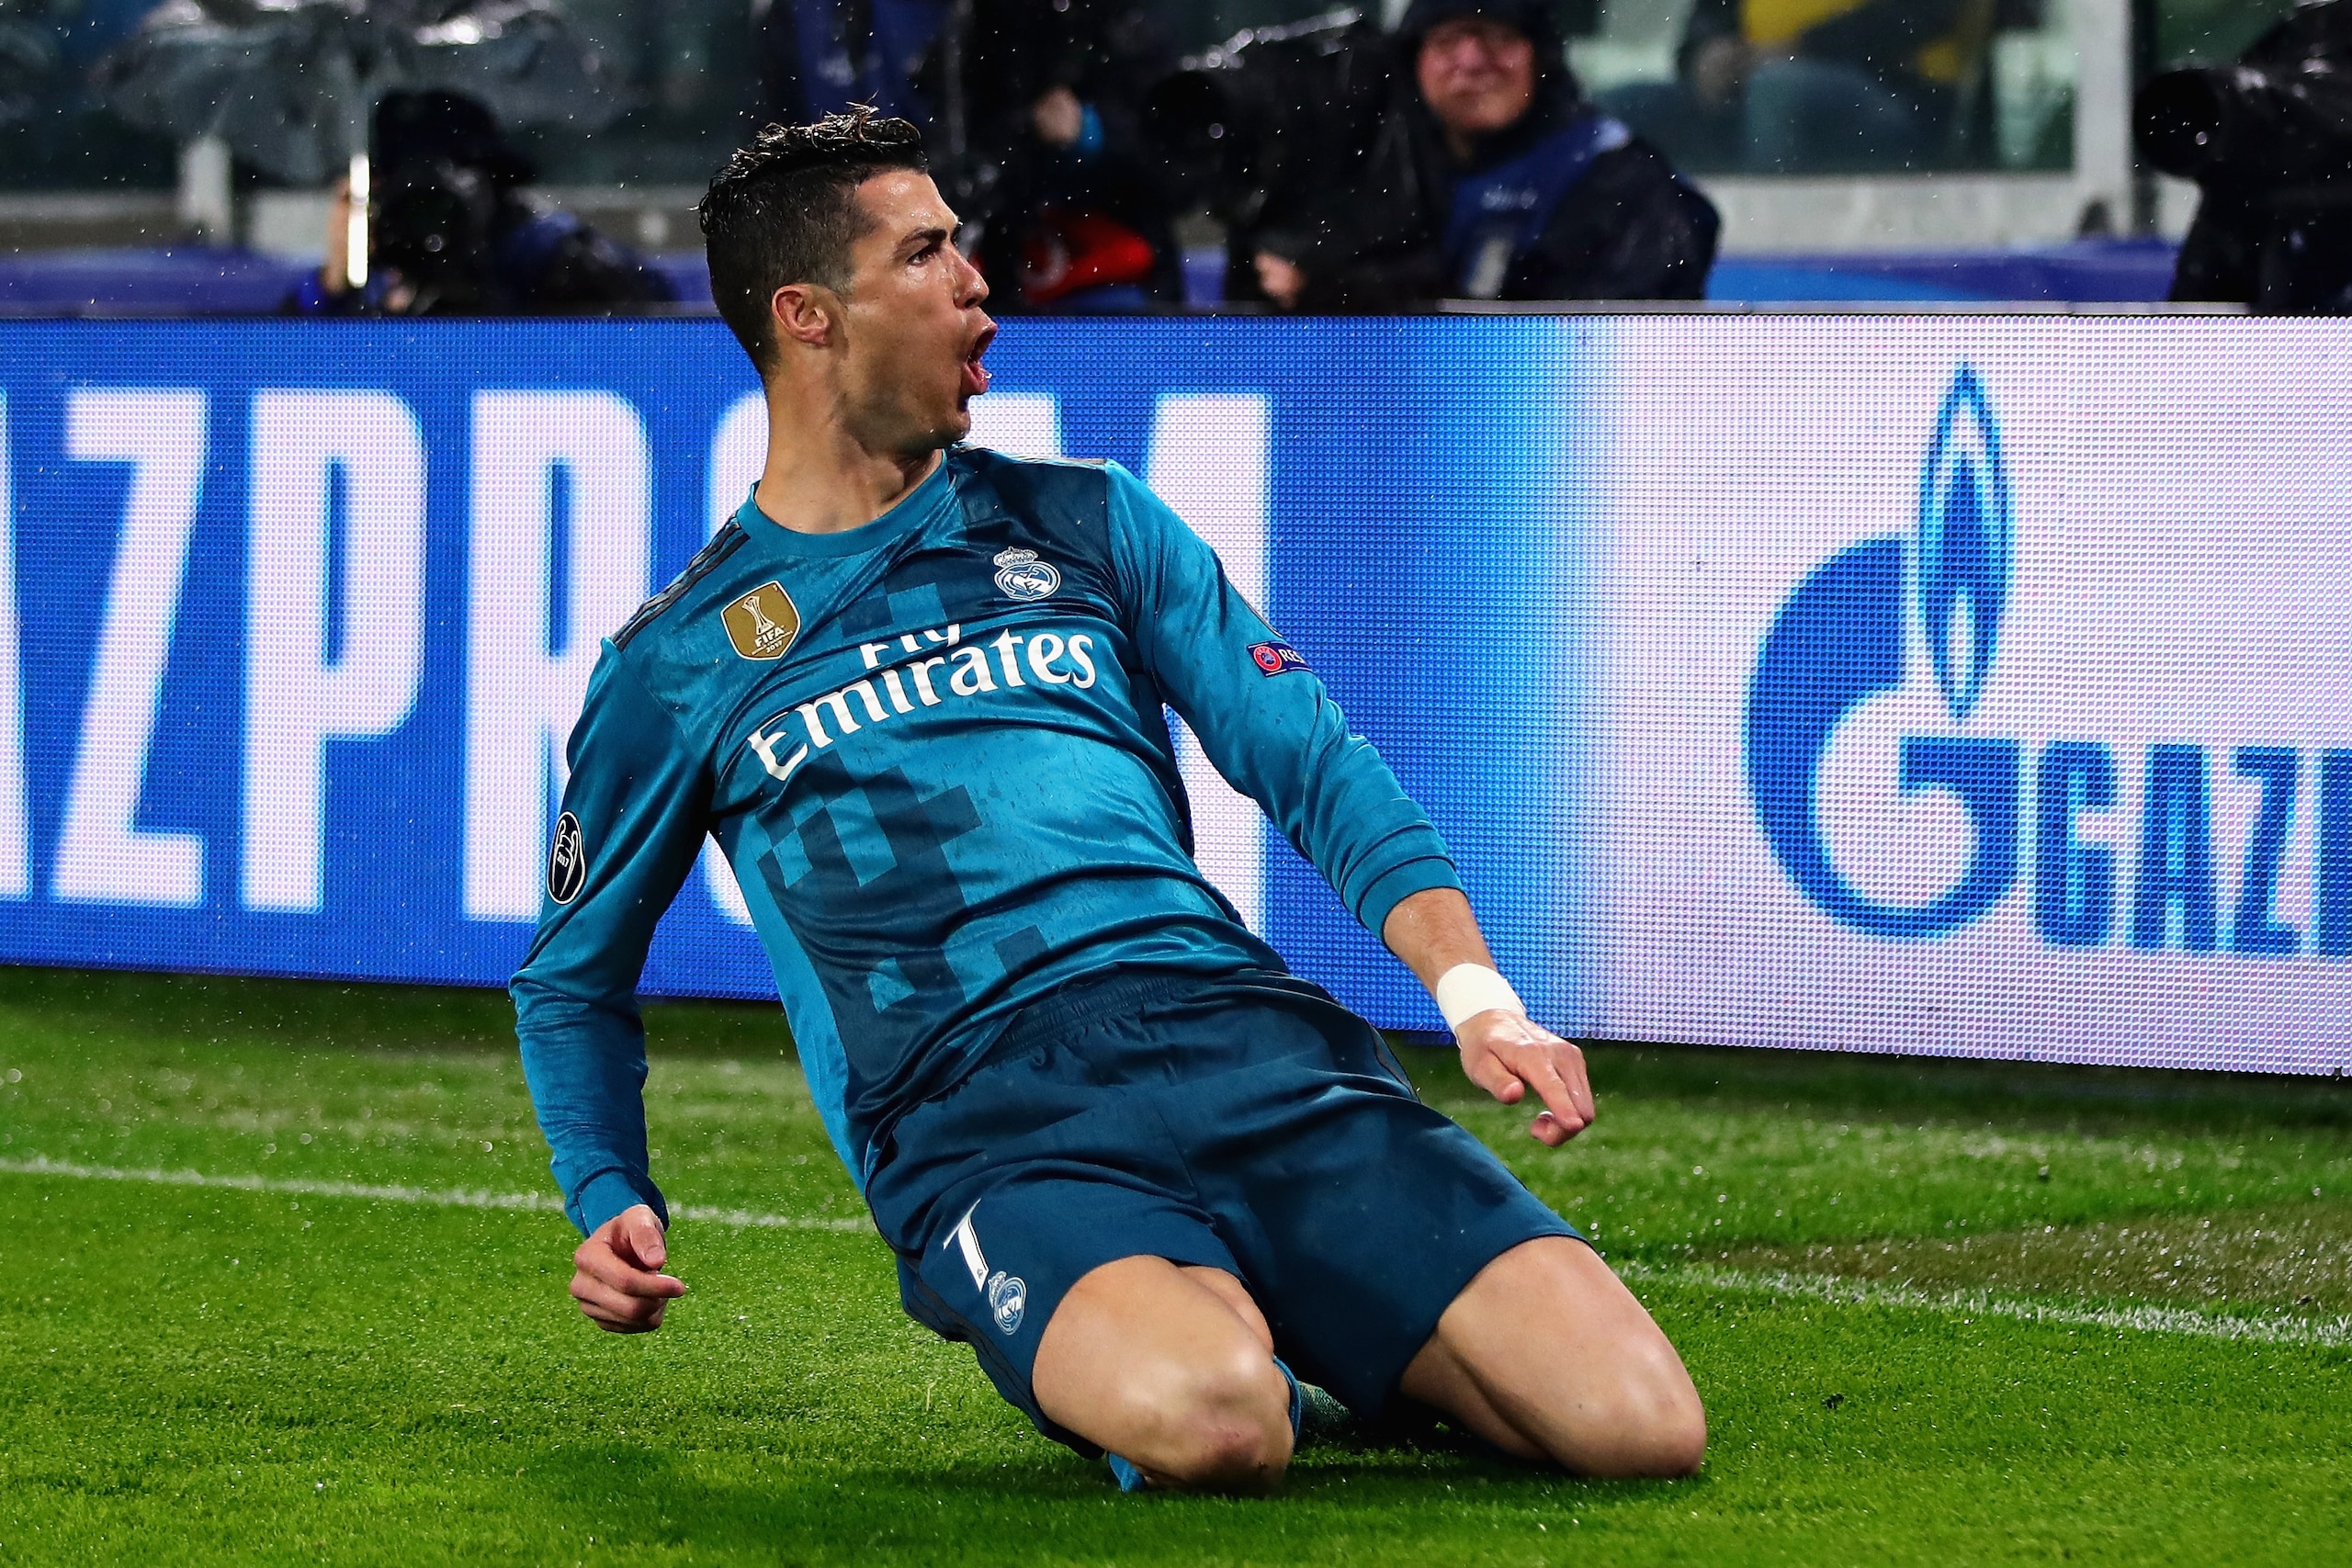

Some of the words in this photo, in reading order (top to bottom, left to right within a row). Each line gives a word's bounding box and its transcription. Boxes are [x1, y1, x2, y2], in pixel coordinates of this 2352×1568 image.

[754, 626, 786, 648] FIFA
[765, 640, 784, 653] 2017
[747, 627, 1097, 782] Emirates
